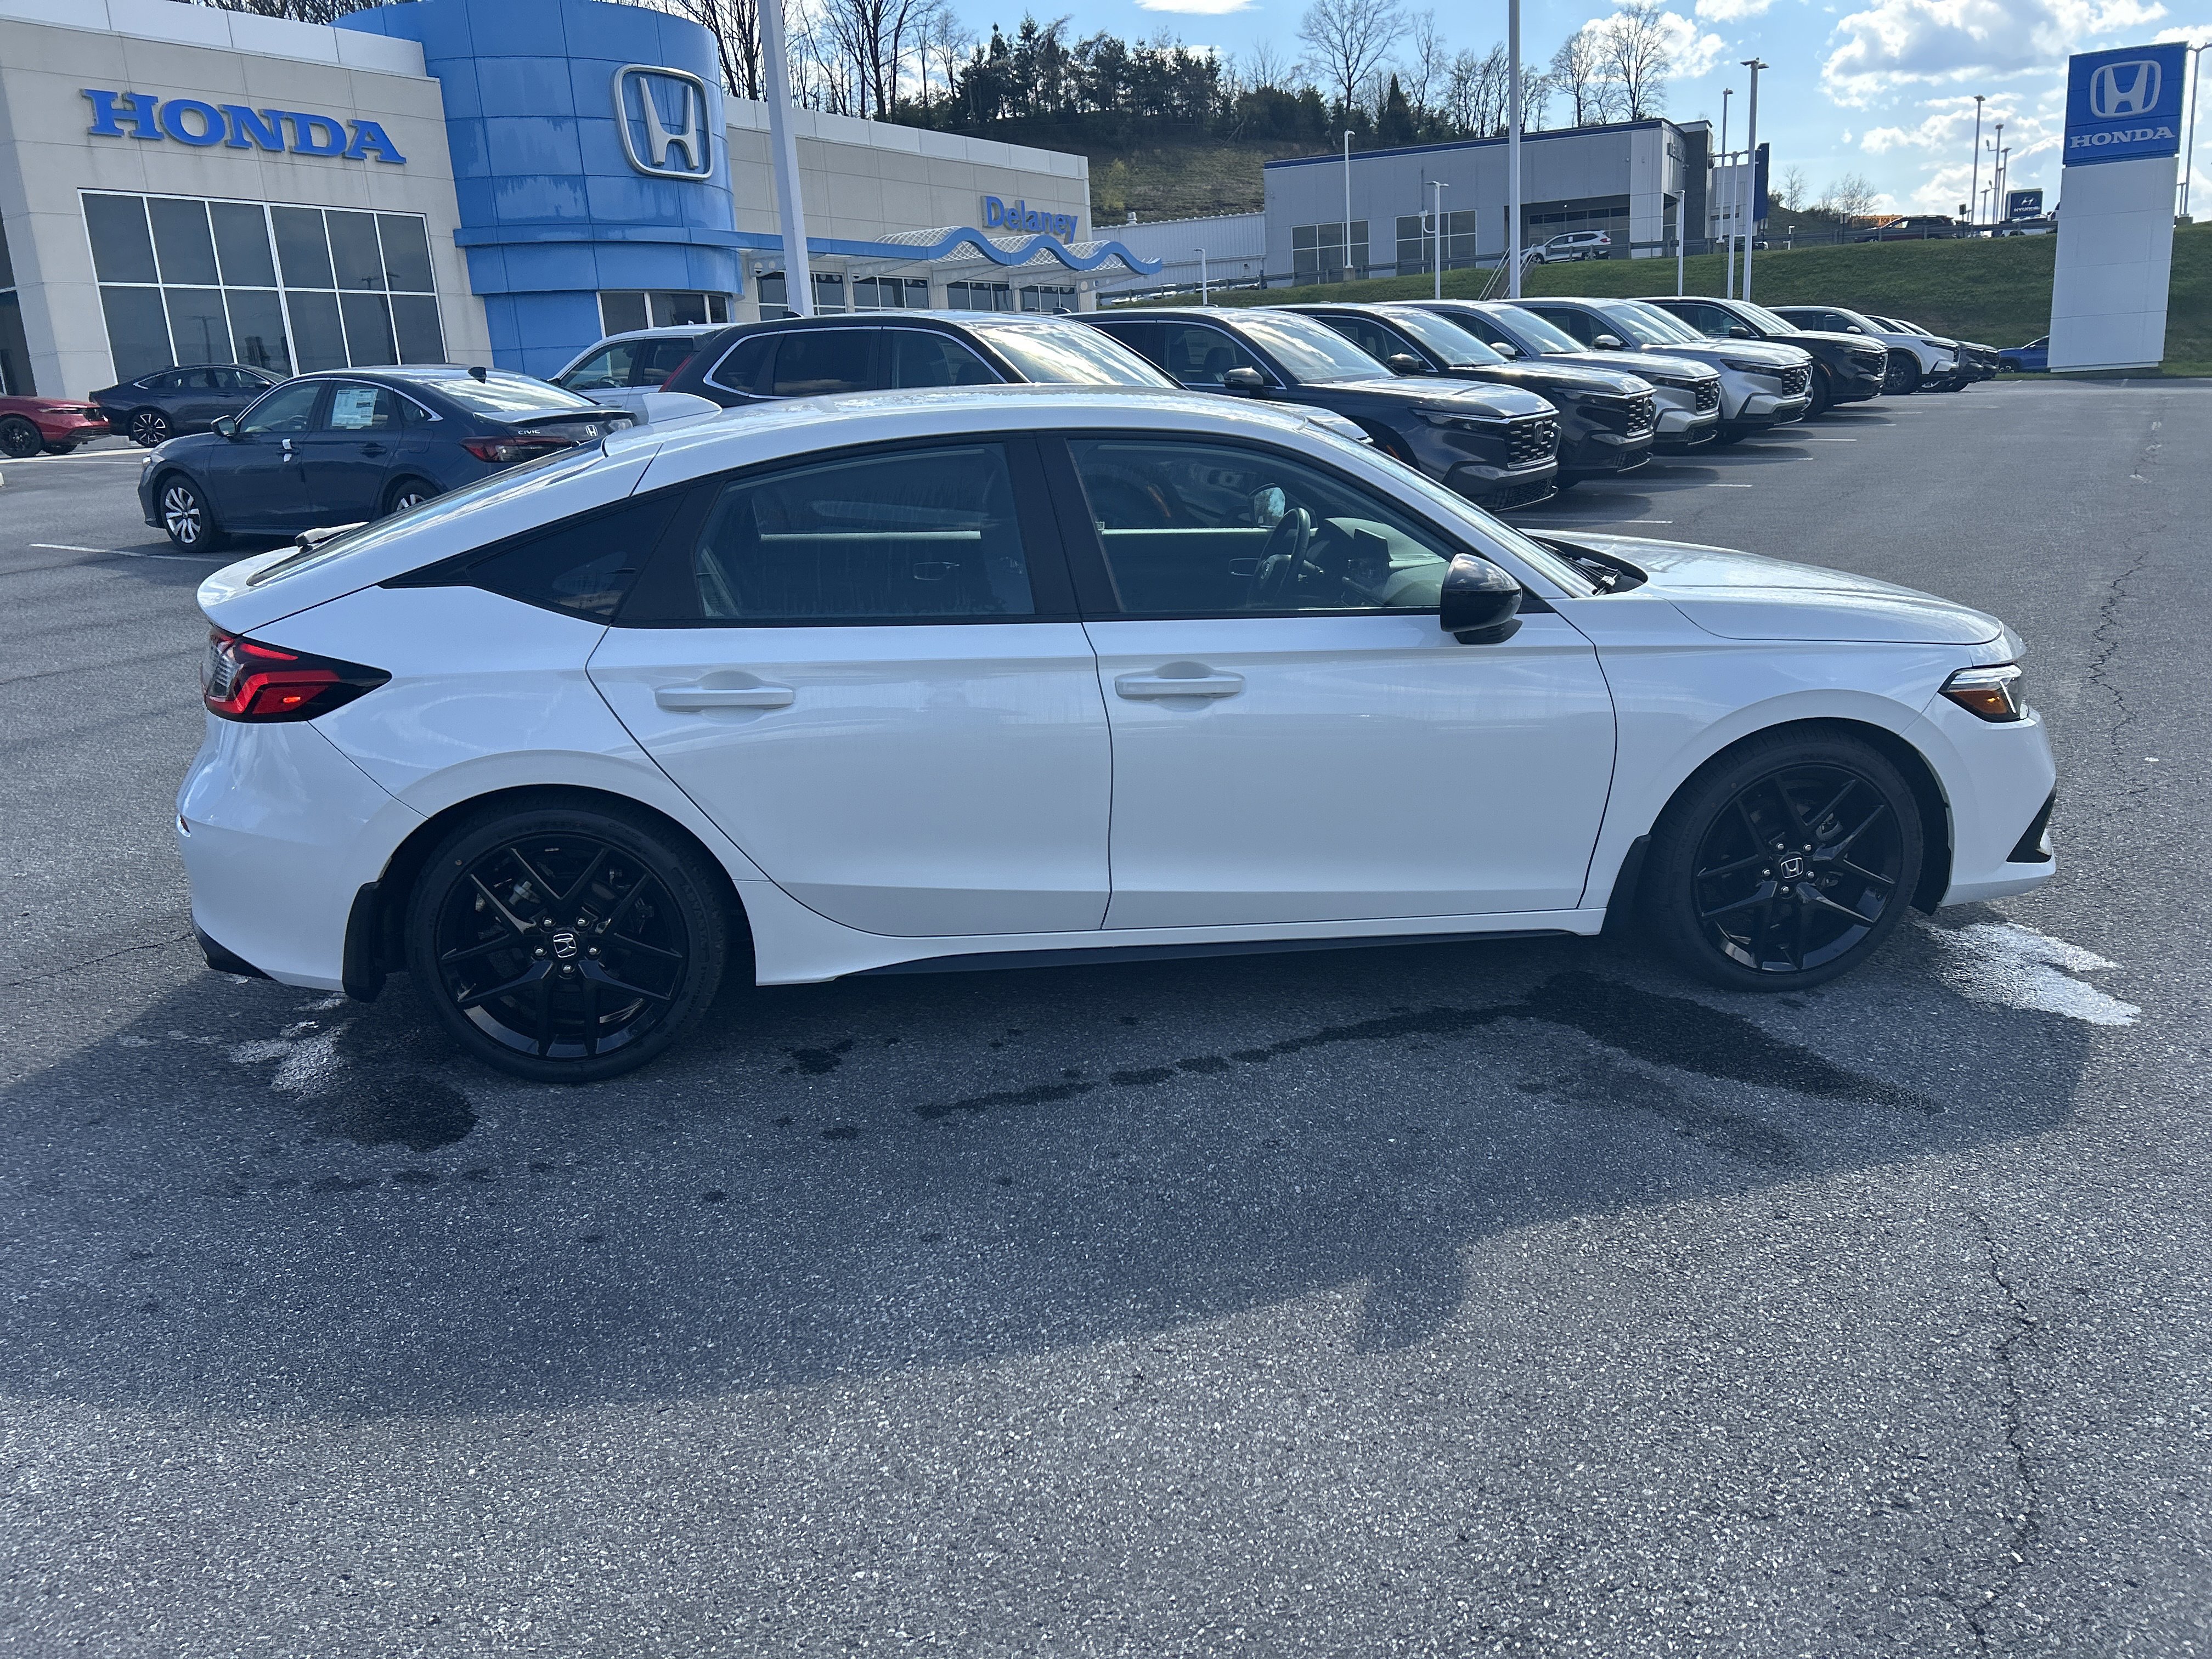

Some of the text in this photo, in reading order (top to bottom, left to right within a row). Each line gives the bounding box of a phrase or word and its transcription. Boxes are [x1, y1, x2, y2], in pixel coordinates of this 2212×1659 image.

[81, 89, 407, 164] HONDA
[2070, 126, 2176, 149] HONDA
[981, 195, 1078, 244] Delaney
